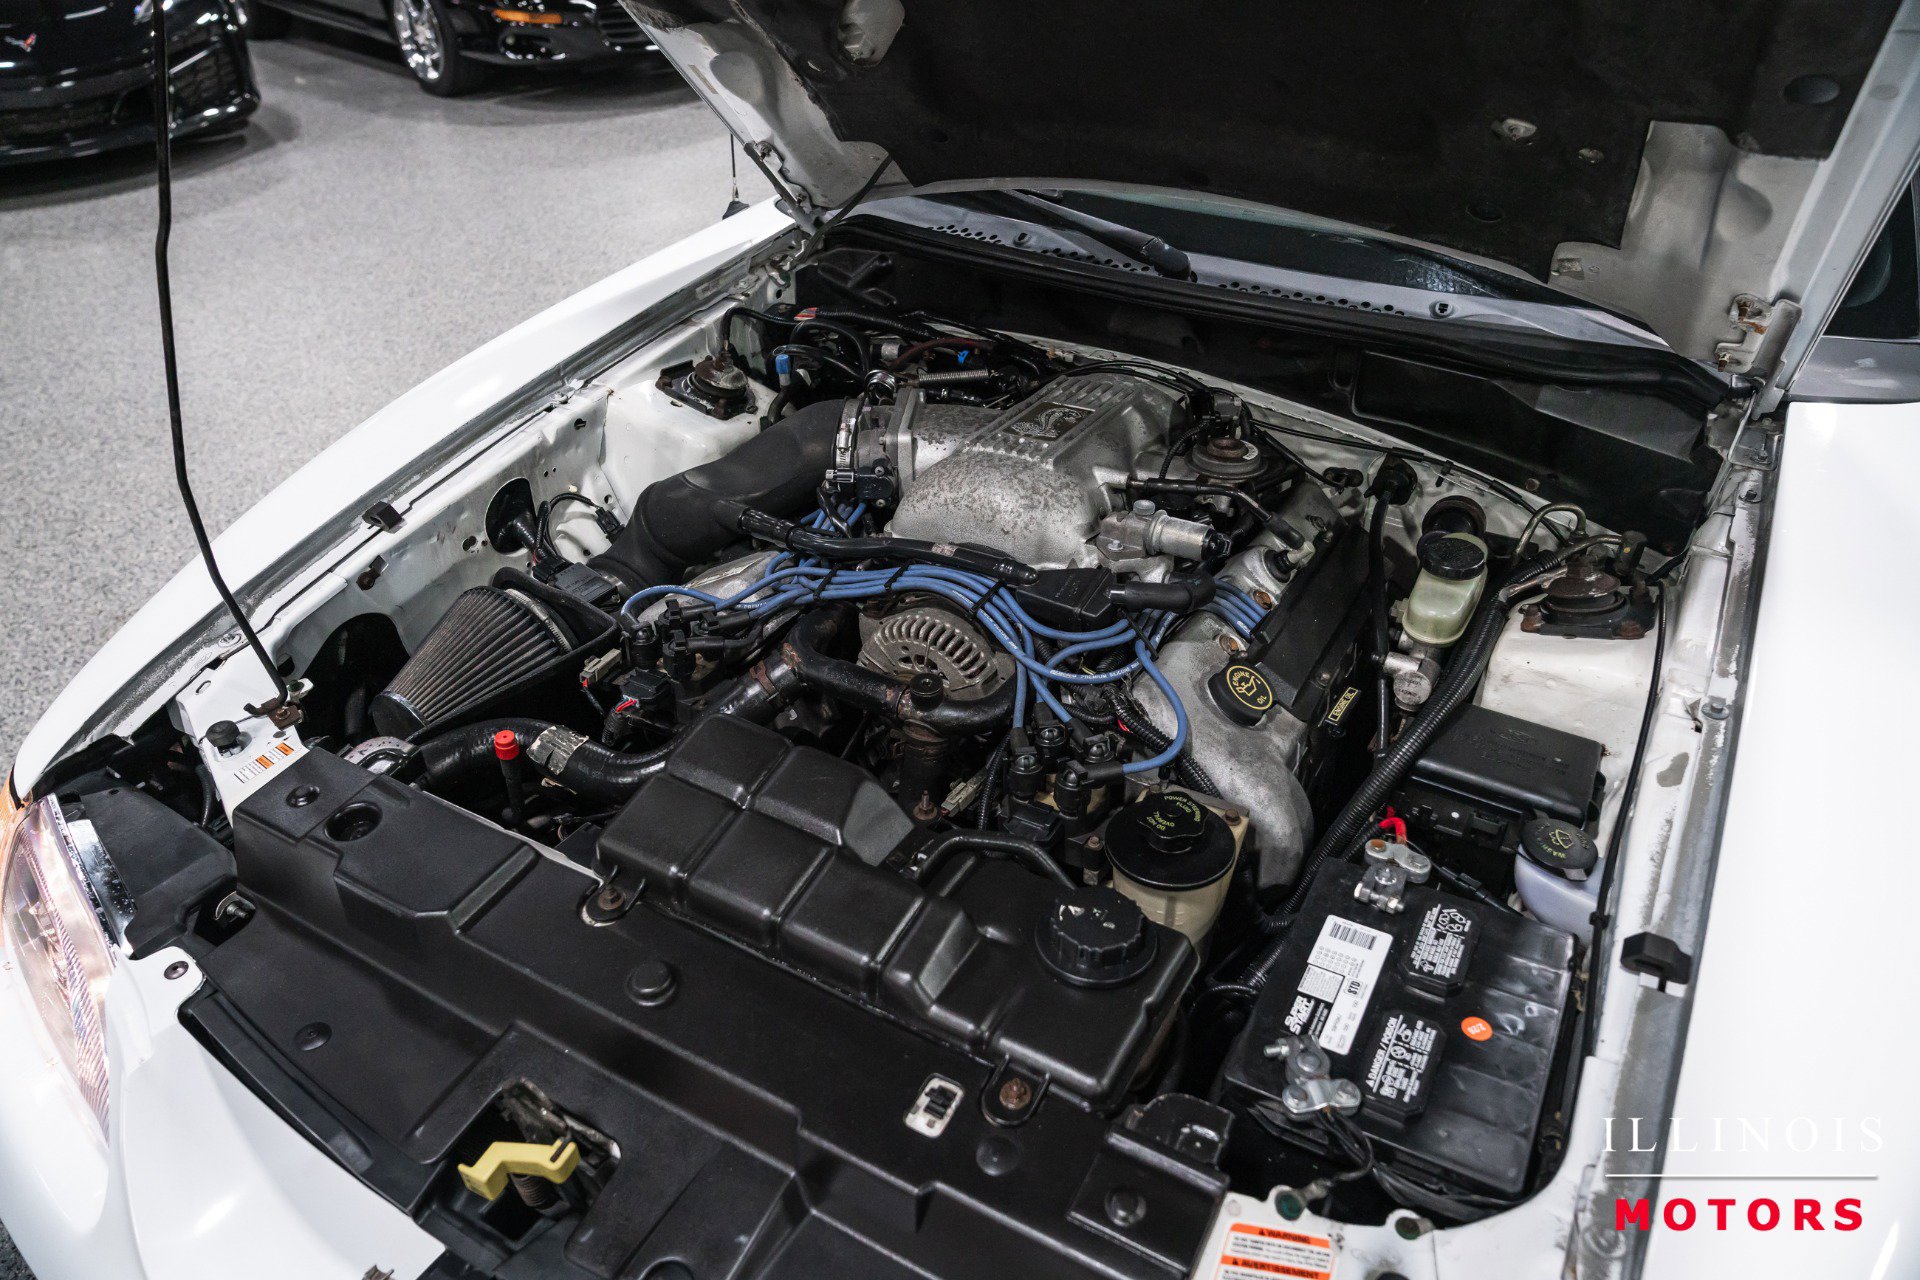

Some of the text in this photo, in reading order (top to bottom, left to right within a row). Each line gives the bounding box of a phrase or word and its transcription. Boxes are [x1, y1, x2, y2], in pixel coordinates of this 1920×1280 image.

[1232, 670, 1250, 686] ENGINE
[1257, 695, 1267, 704] OIL
[1333, 691, 1354, 717] ENGINE OIL
[1164, 795, 1188, 803] POWER
[1176, 802, 1191, 813] FLUID
[1347, 980, 1361, 995] STD
[1284, 995, 1307, 1027] SUPER
[1289, 997, 1315, 1036] START
[1367, 1048, 1386, 1081] DANGER
[1380, 1016, 1398, 1045] POISON
[1267, 1229, 1311, 1244] WARNING
[1240, 1258, 1320, 1280] AVERTISSEMENT
